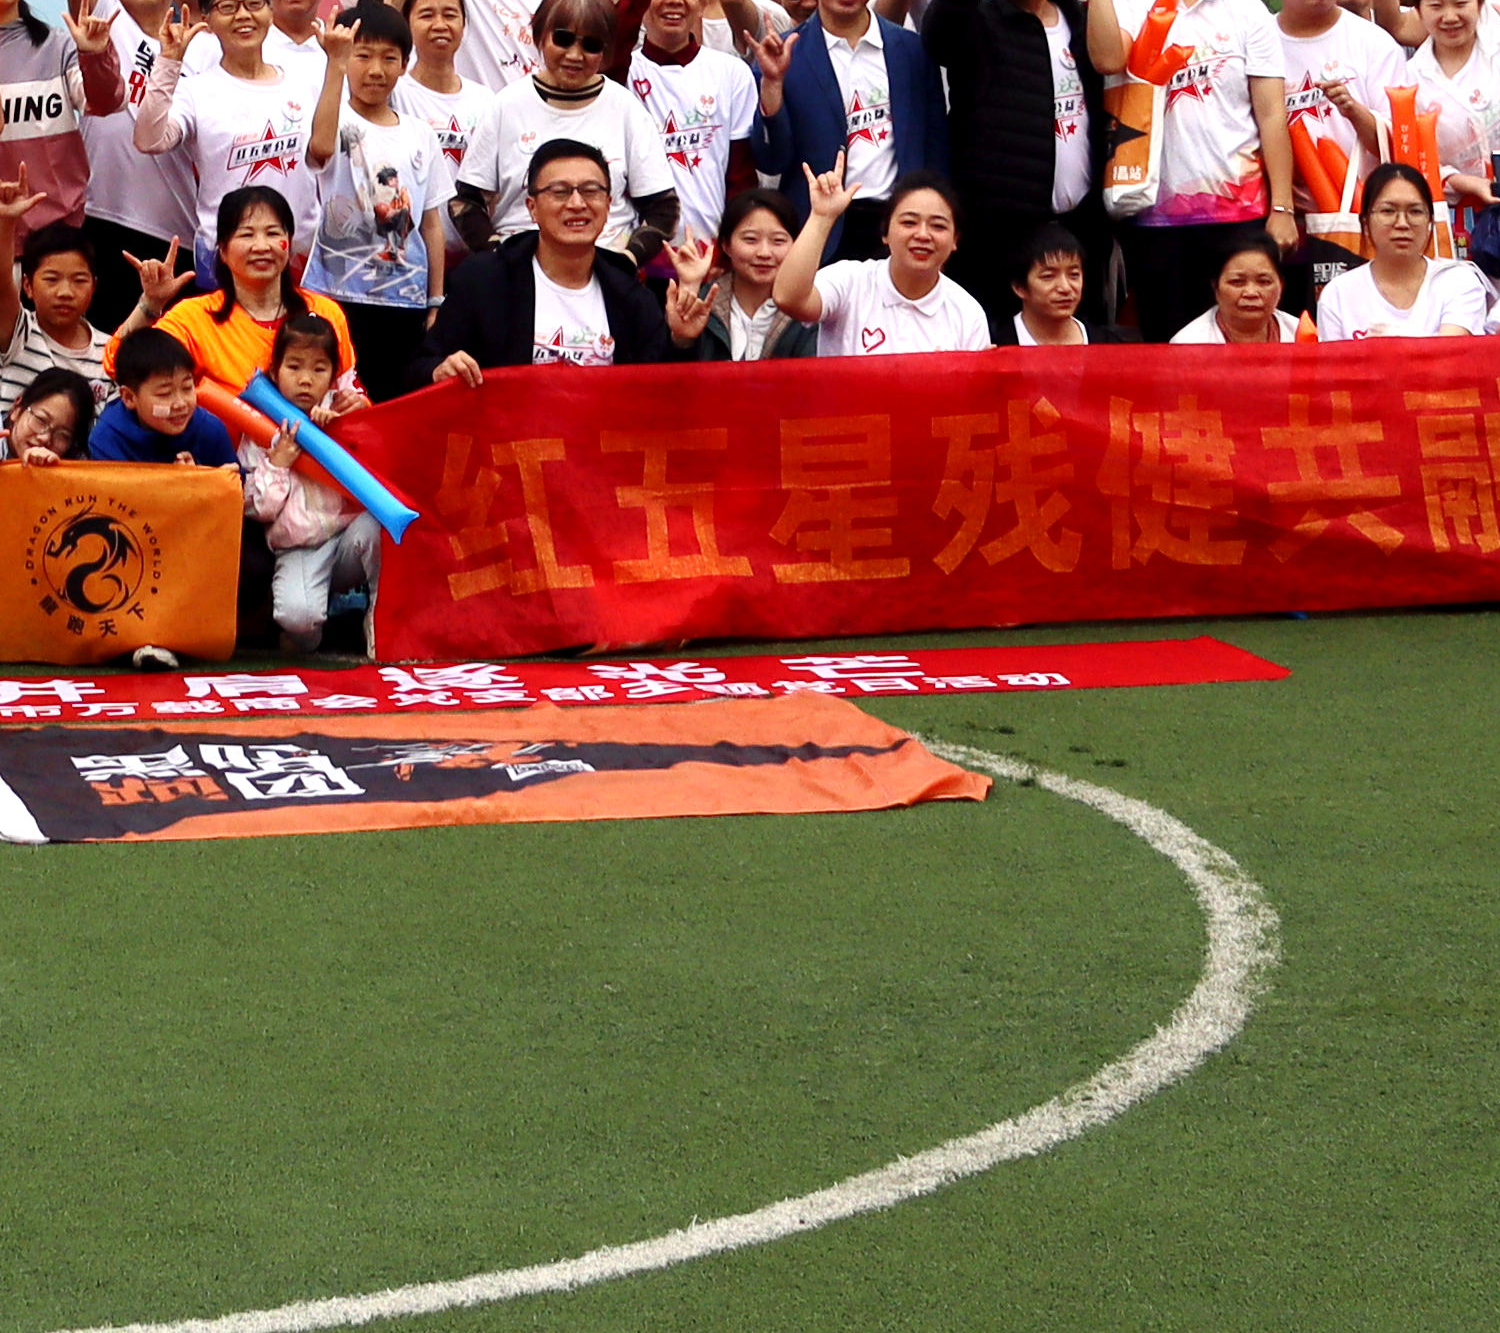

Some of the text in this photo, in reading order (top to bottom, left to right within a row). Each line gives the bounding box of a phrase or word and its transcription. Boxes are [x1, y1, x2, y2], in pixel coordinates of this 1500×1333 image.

[25, 494, 163, 581] DRAGON RUN THE WORLD
